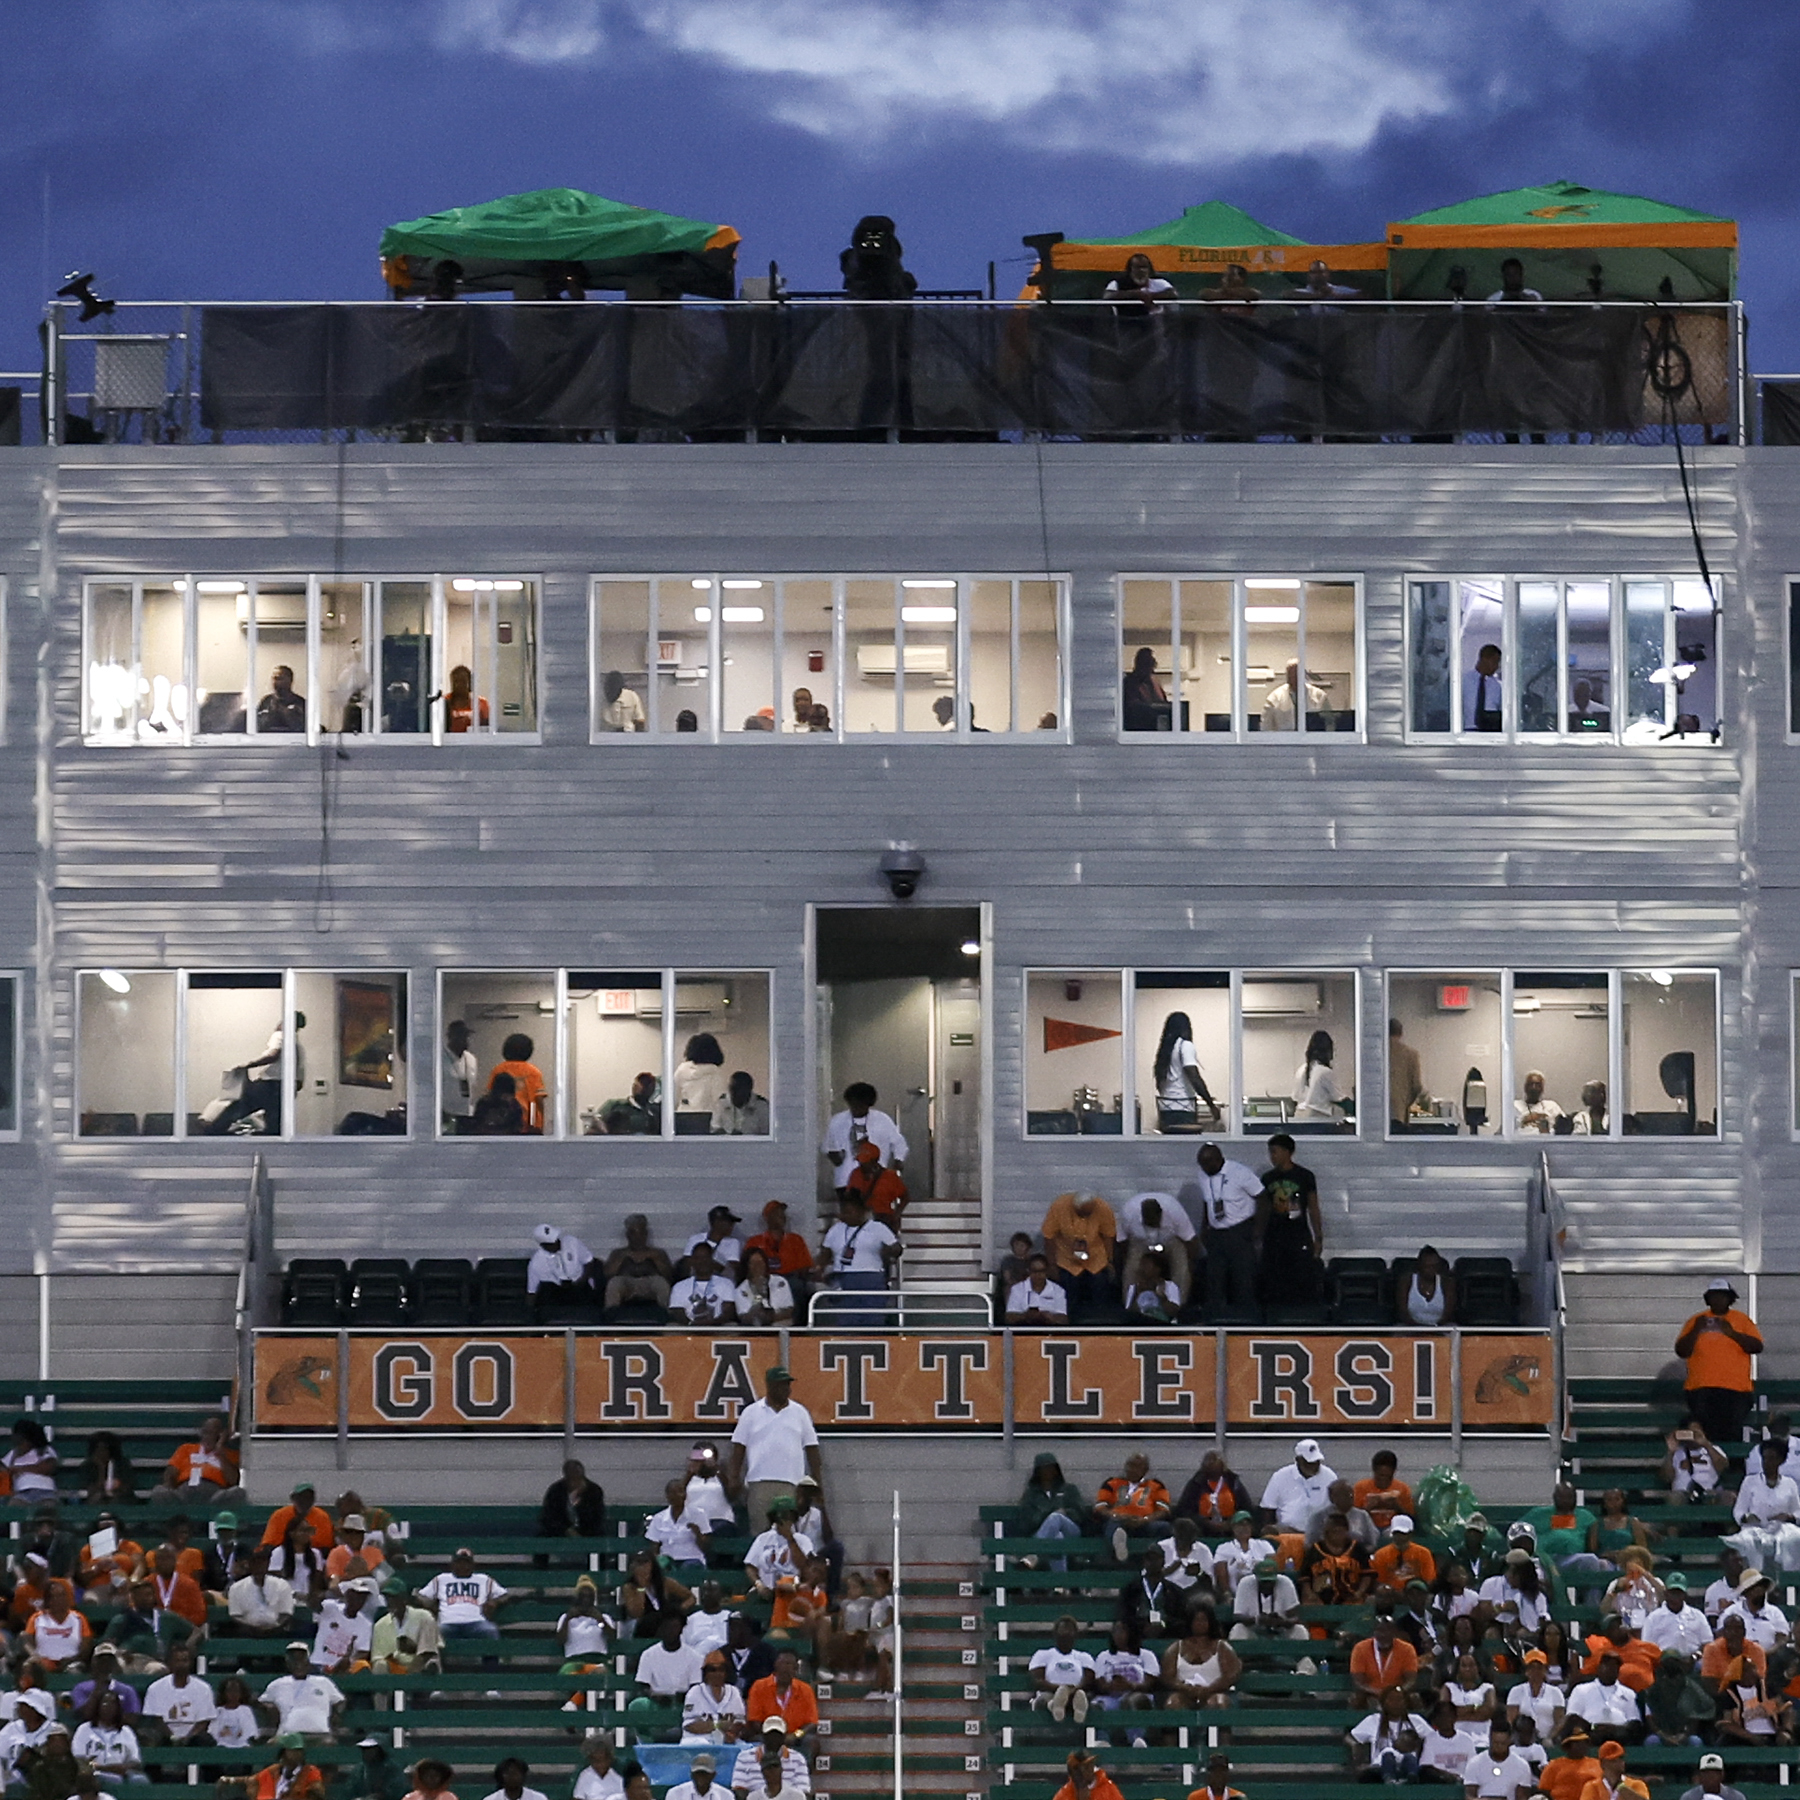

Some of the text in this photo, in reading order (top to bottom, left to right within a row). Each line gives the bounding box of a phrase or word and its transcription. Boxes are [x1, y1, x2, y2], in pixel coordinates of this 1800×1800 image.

[373, 1340, 1435, 1420] GO RATTLERS!
[445, 1582, 479, 1598] FAMU
